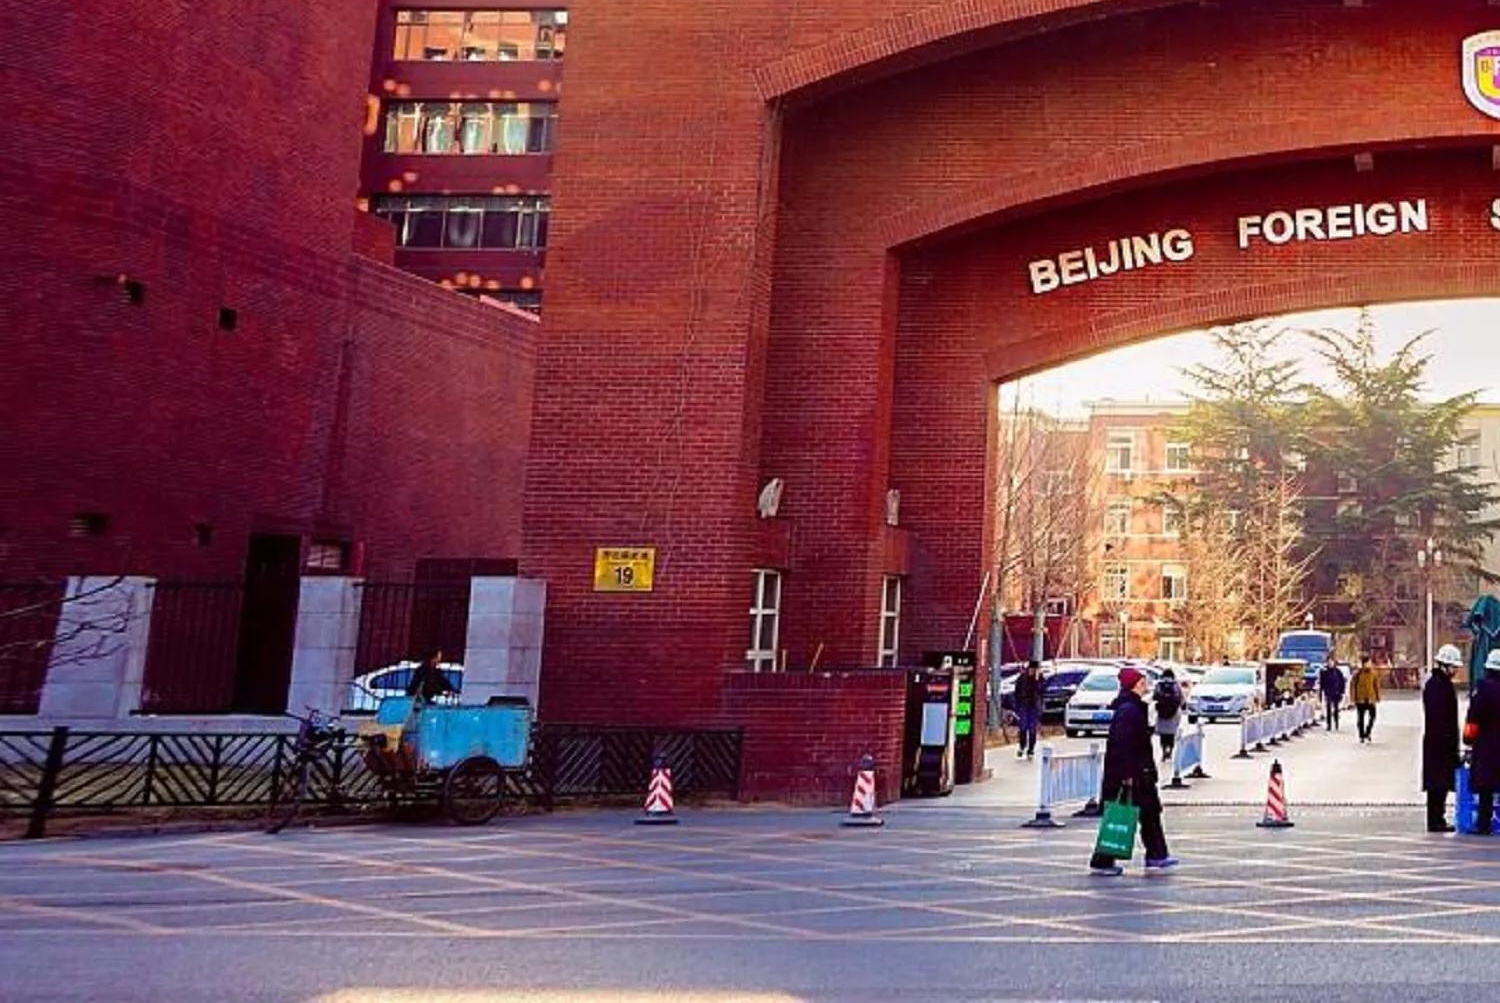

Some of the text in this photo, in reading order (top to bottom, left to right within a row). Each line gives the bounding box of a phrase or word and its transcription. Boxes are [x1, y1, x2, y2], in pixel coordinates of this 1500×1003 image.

[1029, 228, 1194, 294] BEIJING
[1238, 199, 1429, 248] FOREIGN
[615, 566, 634, 584] 19
